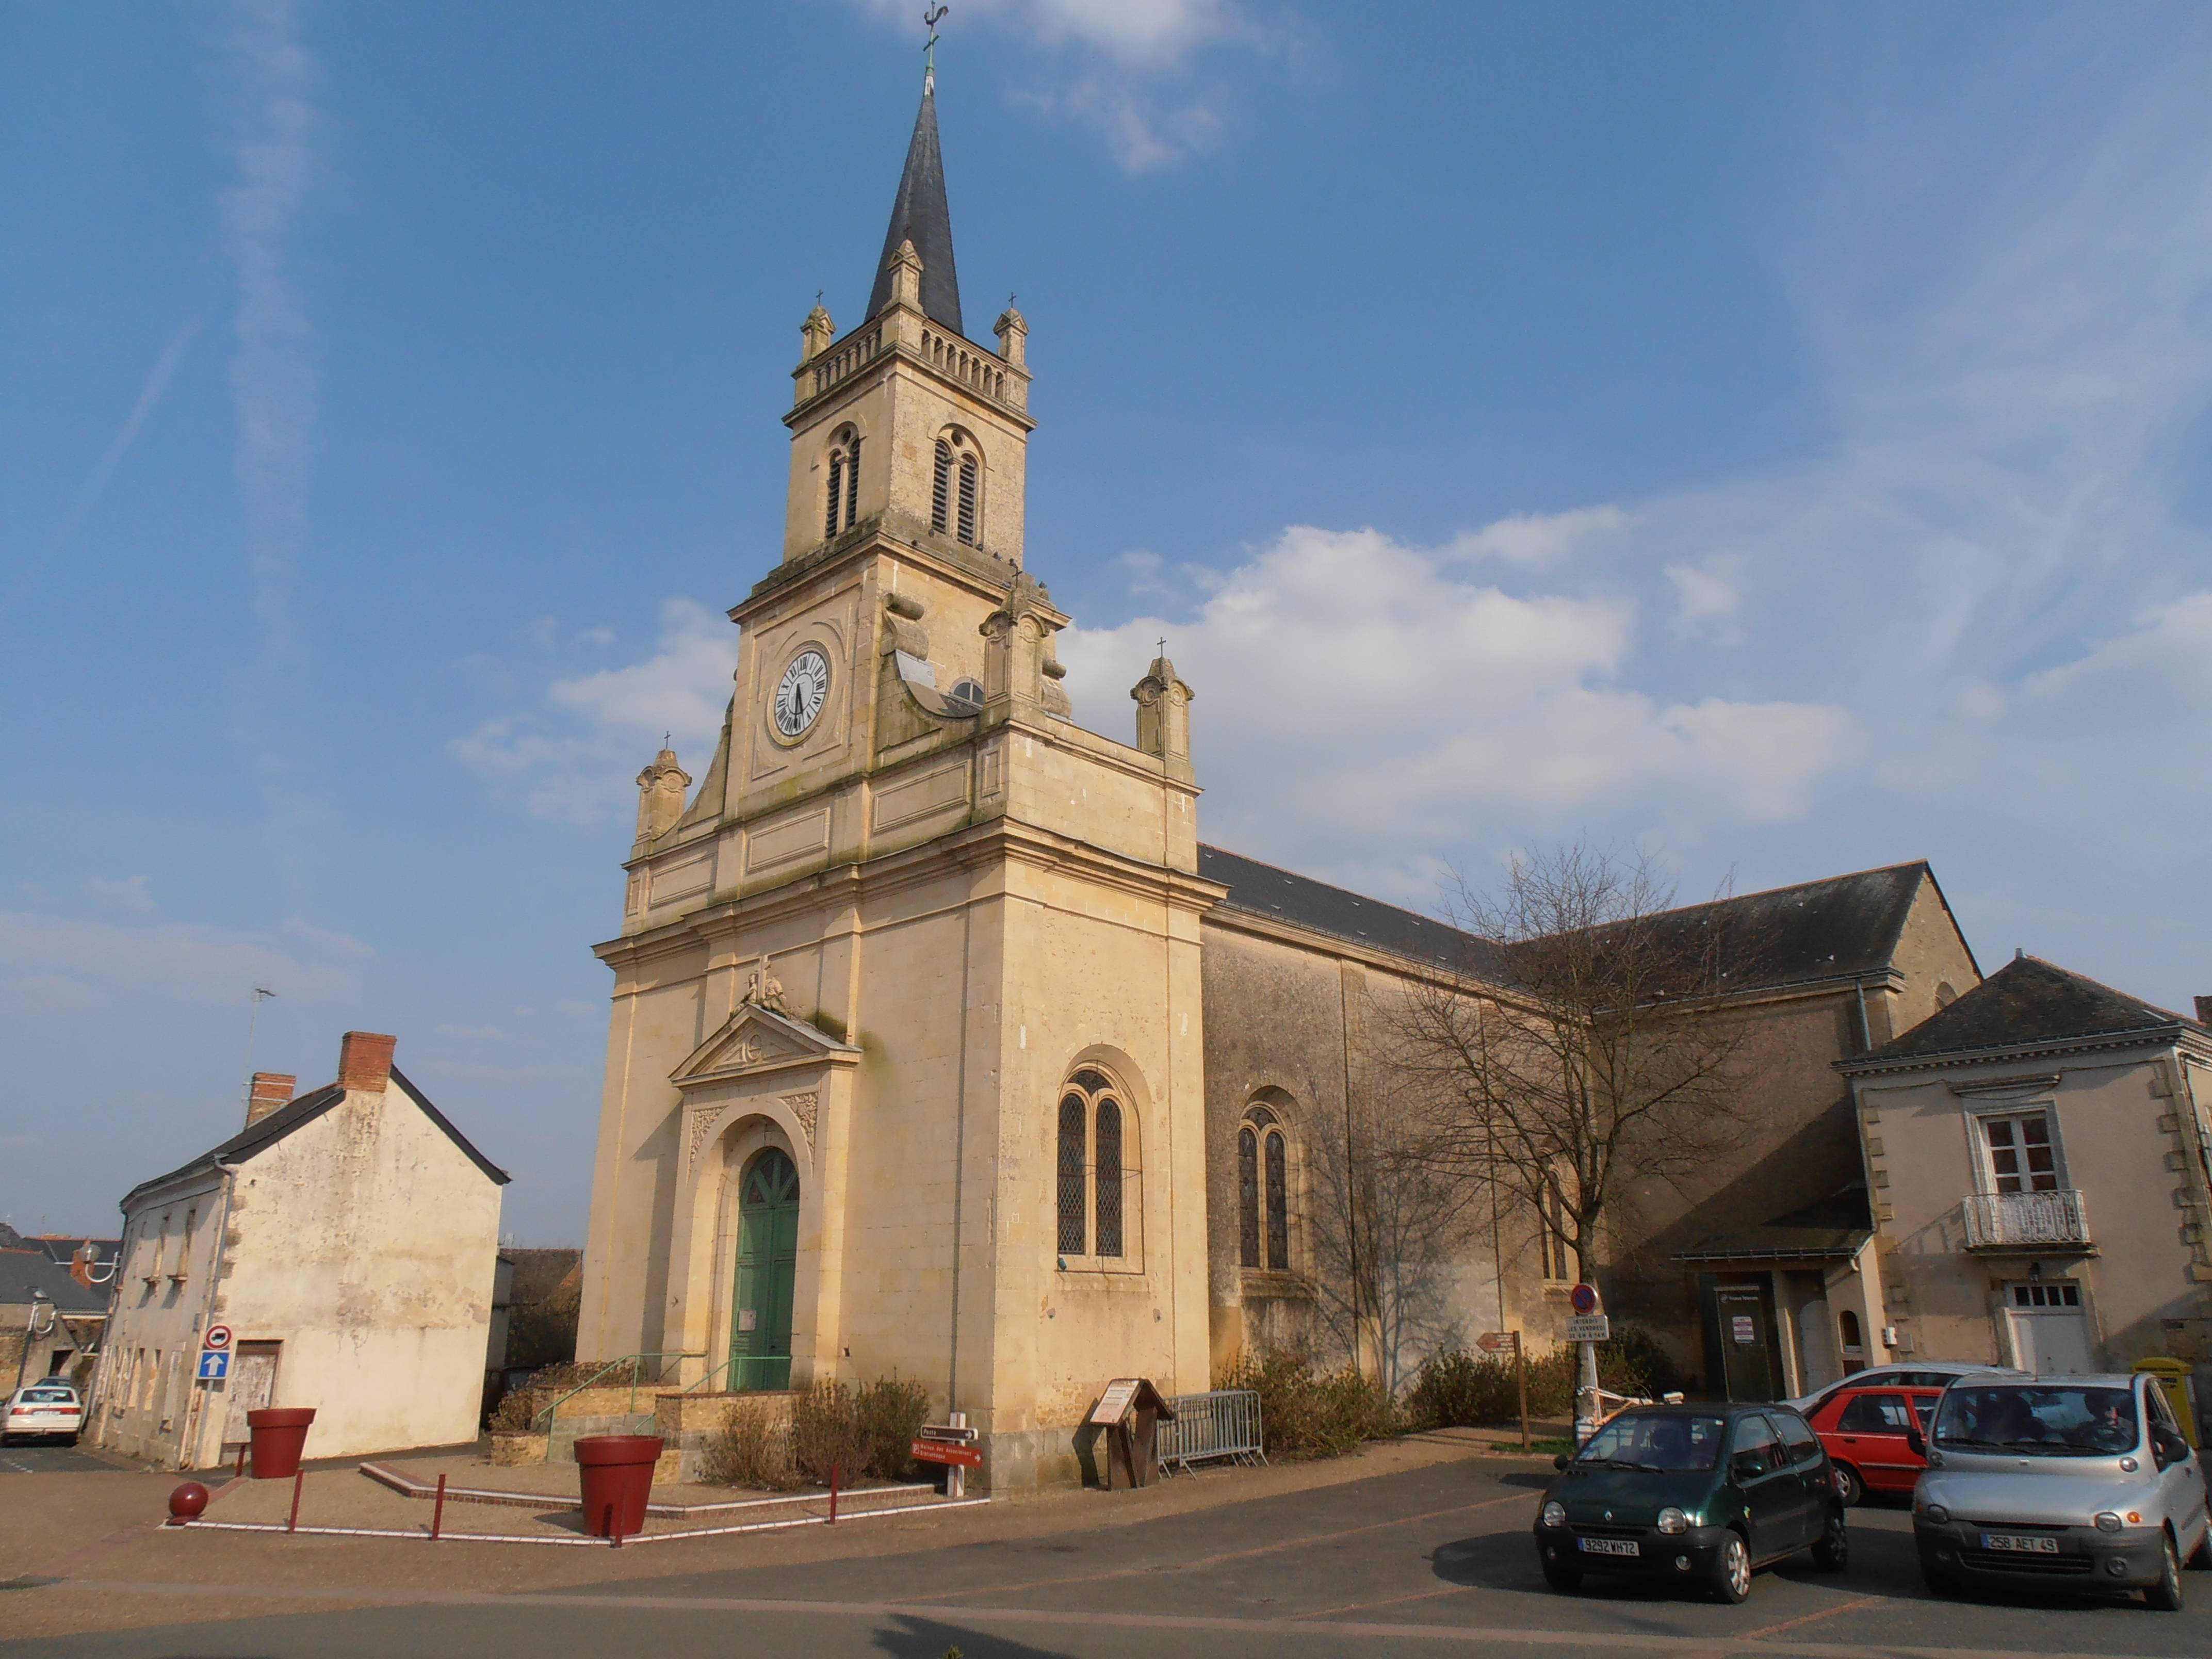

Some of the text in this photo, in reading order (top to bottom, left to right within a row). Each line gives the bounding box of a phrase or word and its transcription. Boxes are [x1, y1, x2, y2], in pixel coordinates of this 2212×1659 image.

[1990, 1536, 2056, 1551] 258 AET 49
